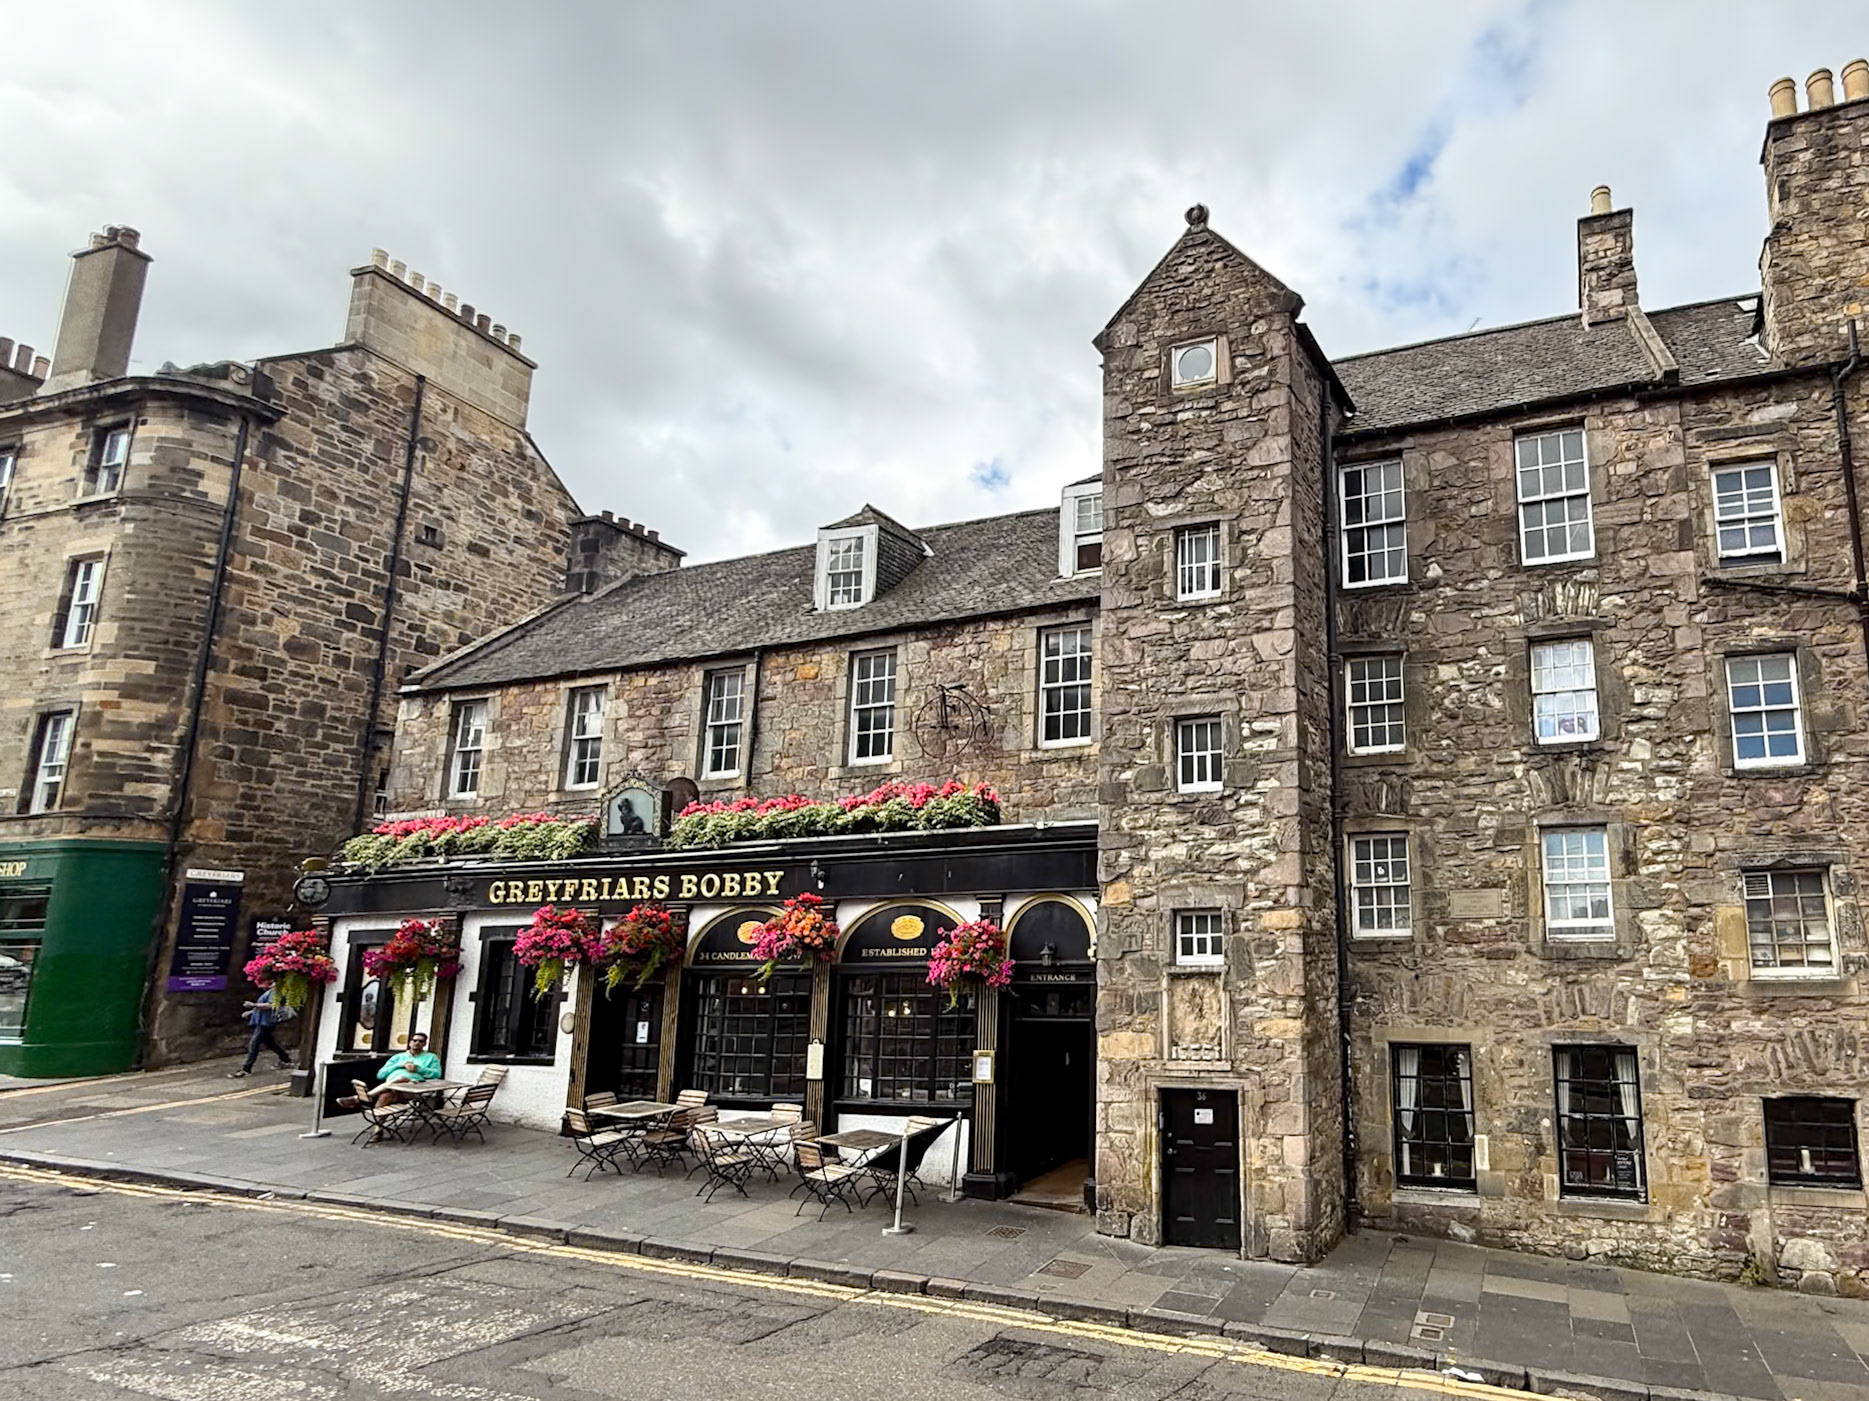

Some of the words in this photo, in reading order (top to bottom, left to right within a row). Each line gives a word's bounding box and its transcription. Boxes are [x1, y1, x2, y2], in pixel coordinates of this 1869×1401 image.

[489, 875, 670, 903] GREYFRIARS
[679, 870, 784, 898] BOBBY
[256, 921, 291, 930] Historic
[711, 952, 769, 960] CANDLEMA
[861, 947, 927, 957] ESTABLISHED
[1030, 974, 1076, 982] ENTRANCE
